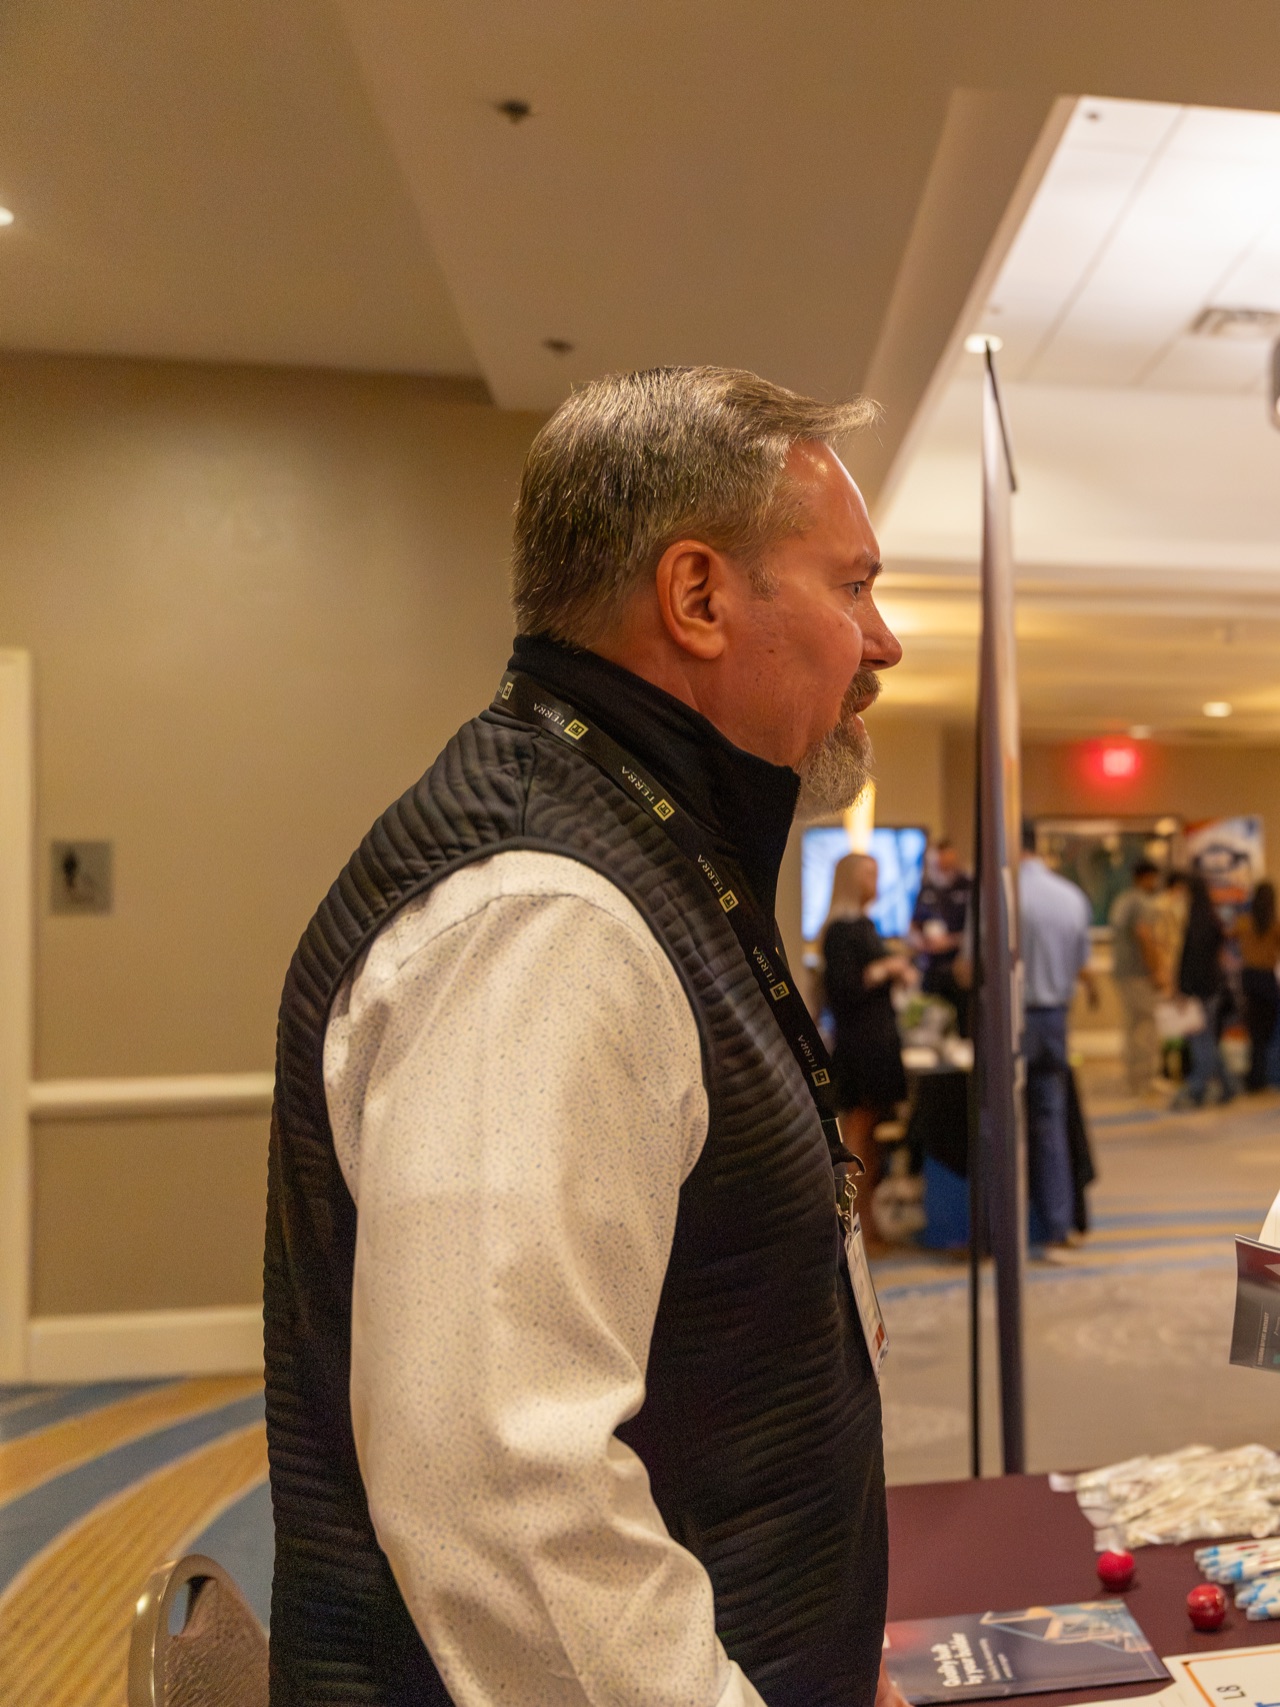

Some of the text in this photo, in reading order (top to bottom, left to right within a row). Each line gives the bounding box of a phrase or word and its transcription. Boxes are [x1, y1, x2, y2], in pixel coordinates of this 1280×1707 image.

[533, 703, 565, 727] TERRA
[621, 766, 655, 804] TERRA
[698, 854, 723, 895] TERRA
[753, 946, 776, 983] TERRA
